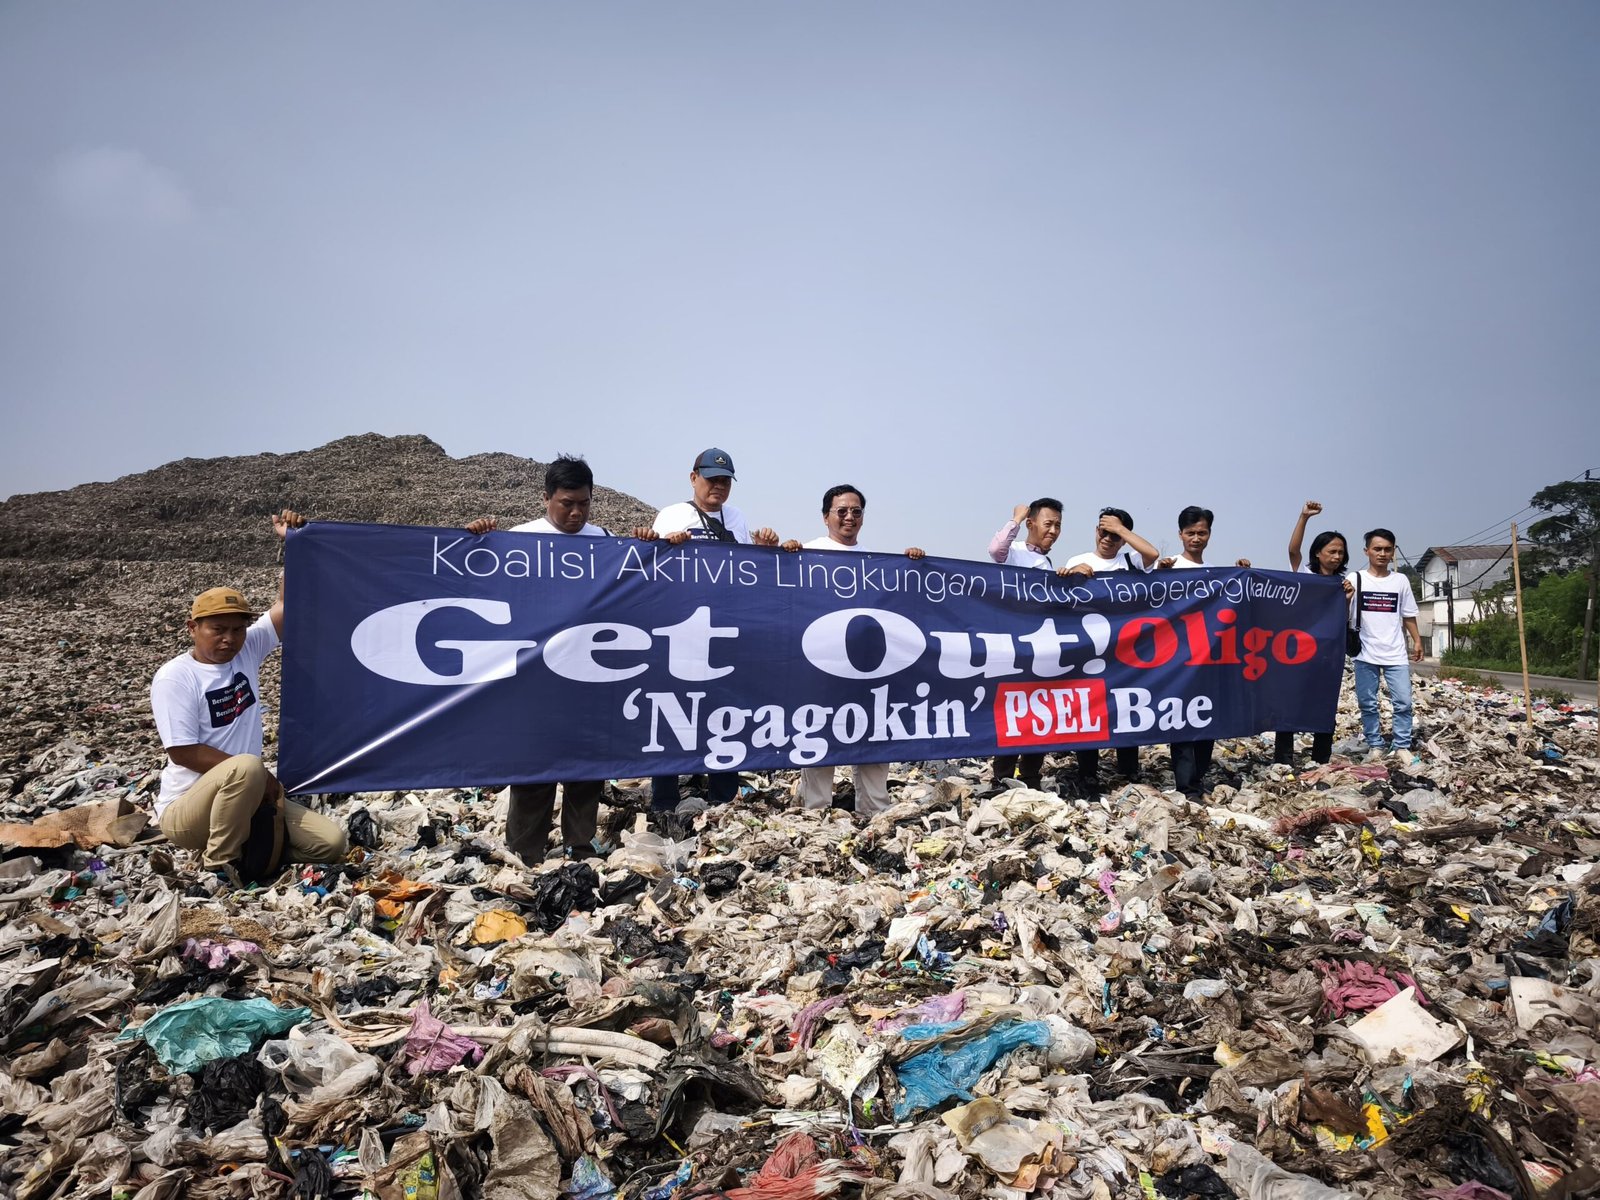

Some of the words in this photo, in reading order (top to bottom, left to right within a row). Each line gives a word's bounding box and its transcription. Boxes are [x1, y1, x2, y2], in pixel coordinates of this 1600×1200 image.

[433, 536, 596, 580] Koalisi
[617, 545, 758, 586] Aktivis
[777, 555, 987, 602] Lingkungan
[1000, 571, 1093, 608] Hidup
[351, 598, 739, 685] Get
[802, 608, 1111, 680] Out!
[1115, 609, 1317, 680] Oligo
[1005, 688, 1101, 737] PSEL
[1111, 687, 1213, 733] Bae
